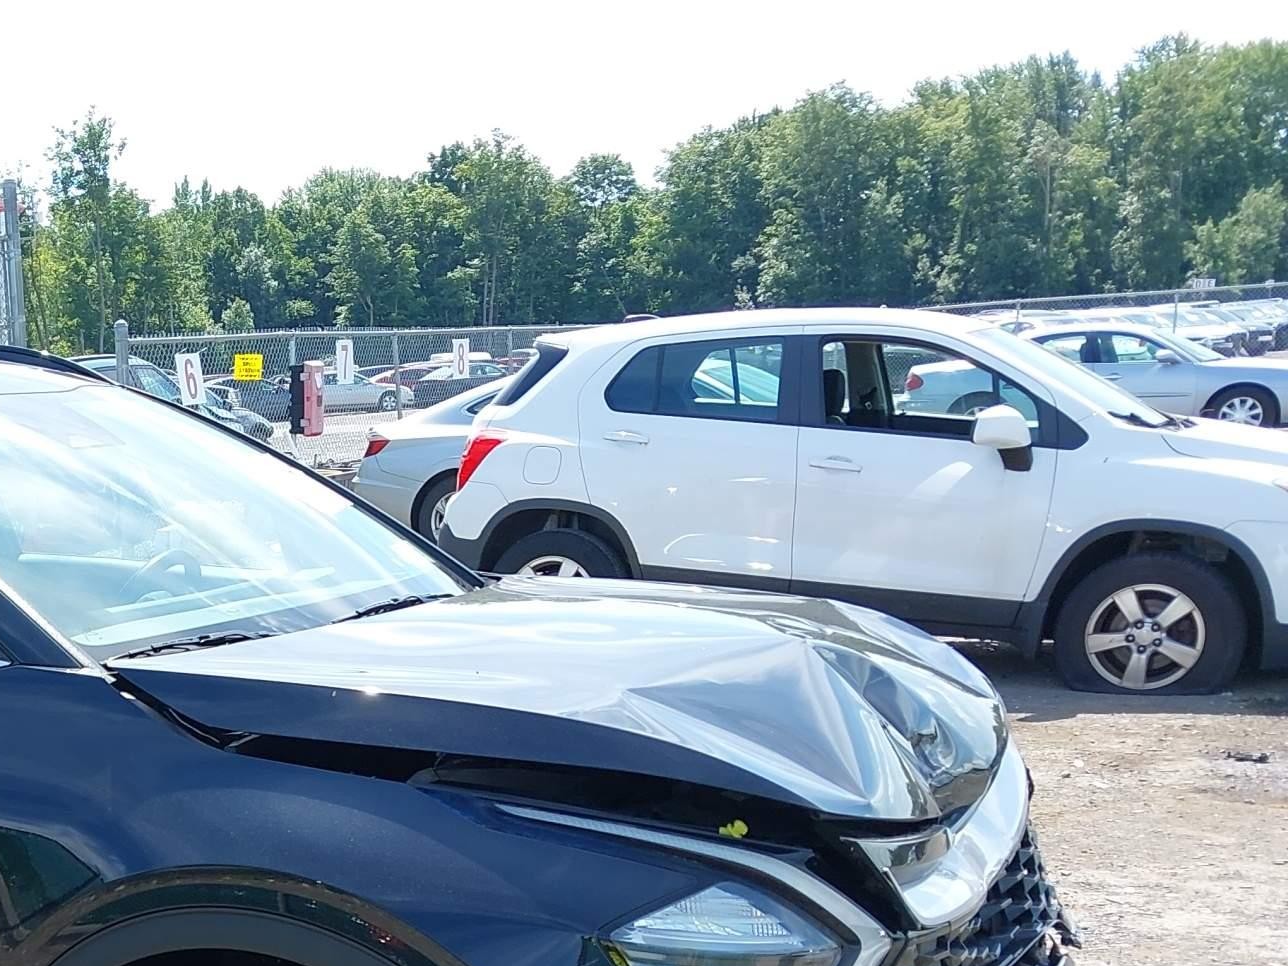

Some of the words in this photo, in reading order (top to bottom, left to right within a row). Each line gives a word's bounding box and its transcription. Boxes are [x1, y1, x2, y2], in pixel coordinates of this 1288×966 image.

[341, 344, 348, 380] 7
[458, 343, 465, 375] 8
[184, 358, 198, 400] 6
